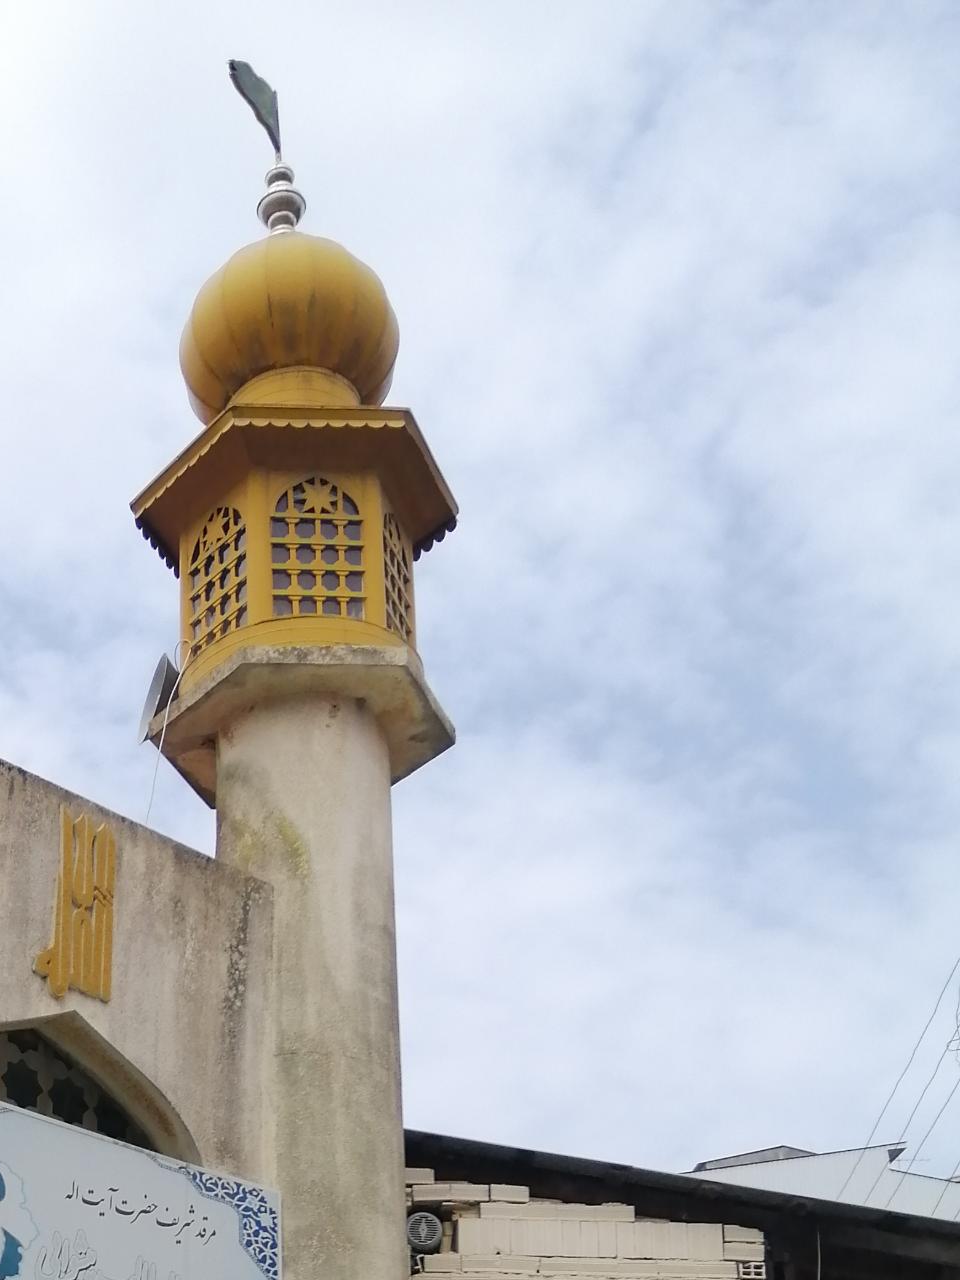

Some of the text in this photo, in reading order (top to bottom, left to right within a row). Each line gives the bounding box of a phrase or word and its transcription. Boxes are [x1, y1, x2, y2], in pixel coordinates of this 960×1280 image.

[81, 1187, 119, 1217] آیت
[114, 1193, 158, 1224] حضرت
[155, 1204, 195, 1245] شریف
[194, 1216, 217, 1246] مرقد
